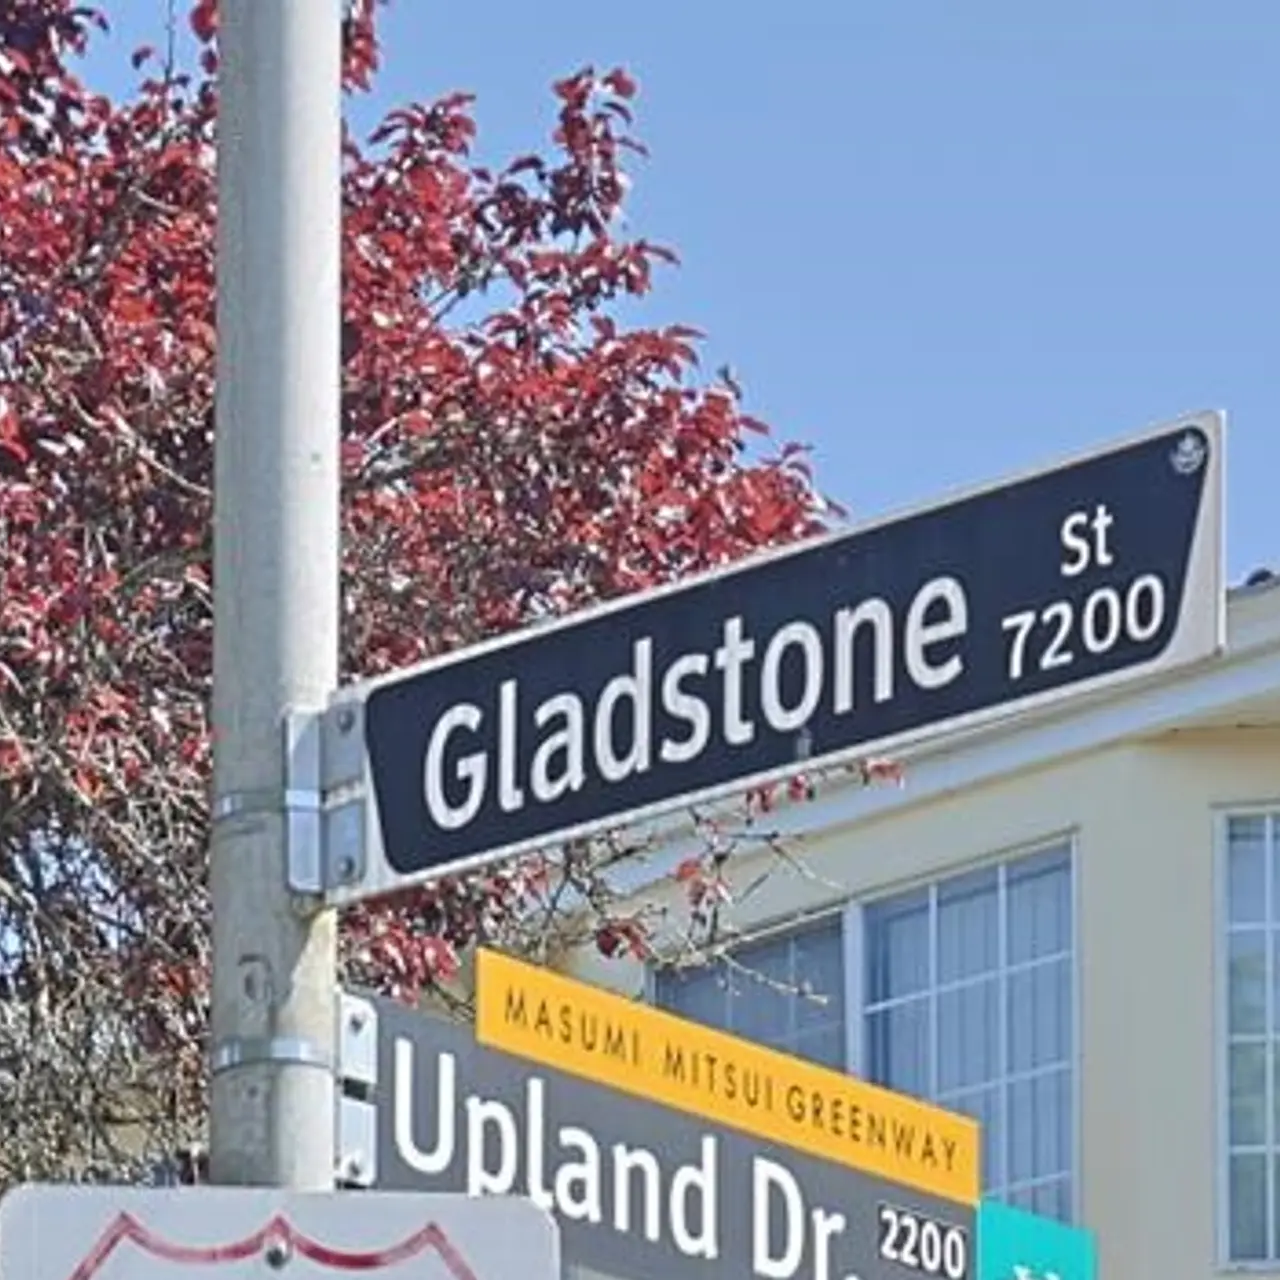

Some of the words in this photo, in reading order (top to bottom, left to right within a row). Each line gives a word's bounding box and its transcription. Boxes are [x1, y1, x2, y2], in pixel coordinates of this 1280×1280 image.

[423, 576, 967, 832] Gladstone
[1060, 504, 1113, 576] St
[1002, 573, 1165, 680] 7200
[394, 1036, 718, 1260] Upland
[880, 1209, 965, 1279] 2200
[505, 984, 638, 1062] MASUMI
[663, 1042, 773, 1109] MITSUI
[786, 1084, 957, 1173] GREENWAY
